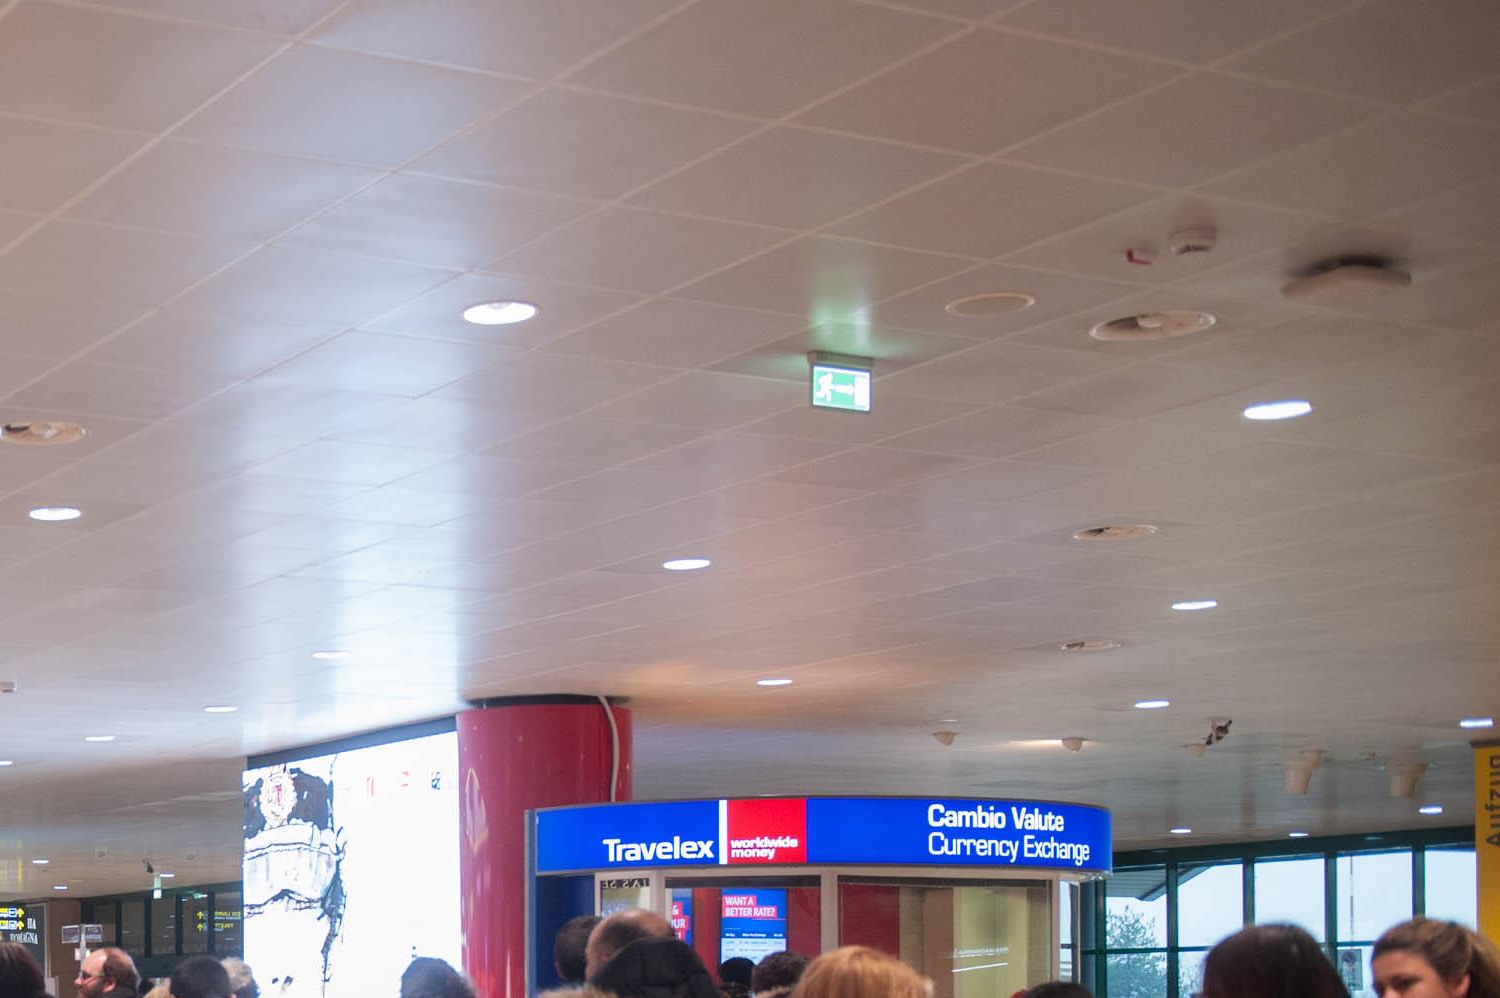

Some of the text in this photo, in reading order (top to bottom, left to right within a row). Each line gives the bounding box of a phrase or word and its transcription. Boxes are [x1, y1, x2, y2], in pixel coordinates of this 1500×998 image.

[928, 803, 1065, 832] Cambio Valute
[602, 836, 714, 862] Travelex
[730, 836, 798, 849] worldwide
[928, 832, 1090, 866] Currency Exchange
[730, 848, 776, 860] money
[724, 896, 754, 906] WANT A
[725, 907, 776, 917] BETTER RATE?
